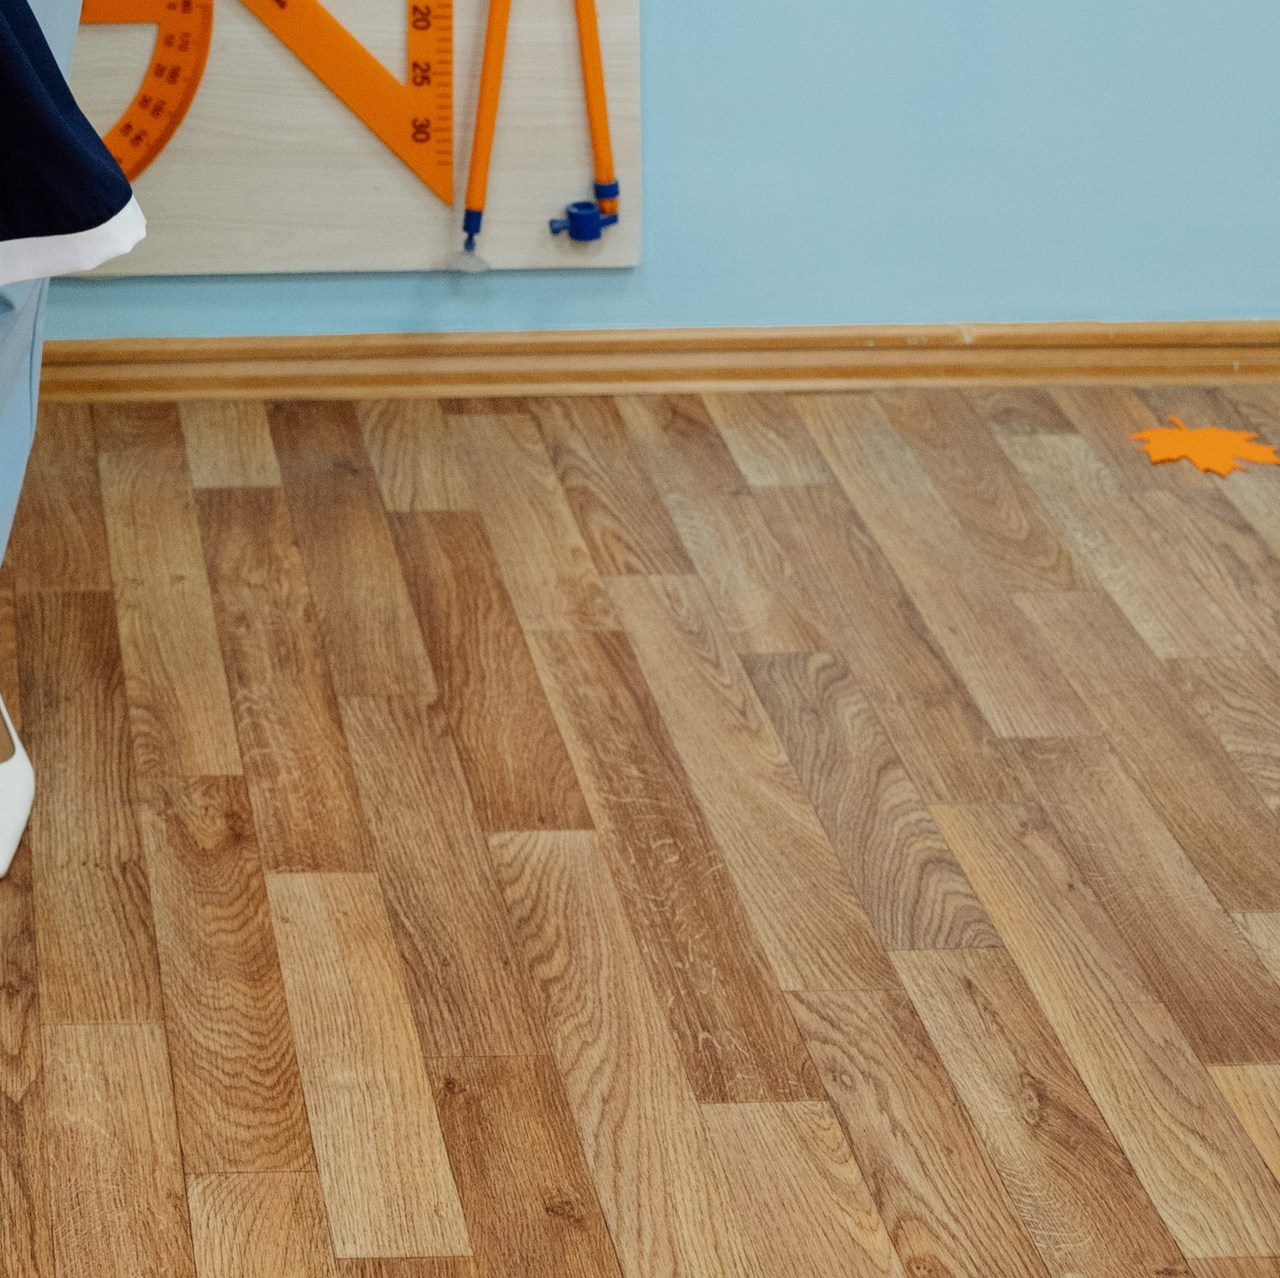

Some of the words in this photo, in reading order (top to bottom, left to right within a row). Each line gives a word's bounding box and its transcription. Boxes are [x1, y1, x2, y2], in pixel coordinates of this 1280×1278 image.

[411, 5, 431, 31] 20
[411, 61, 431, 87] 25
[411, 117, 431, 143] 30
